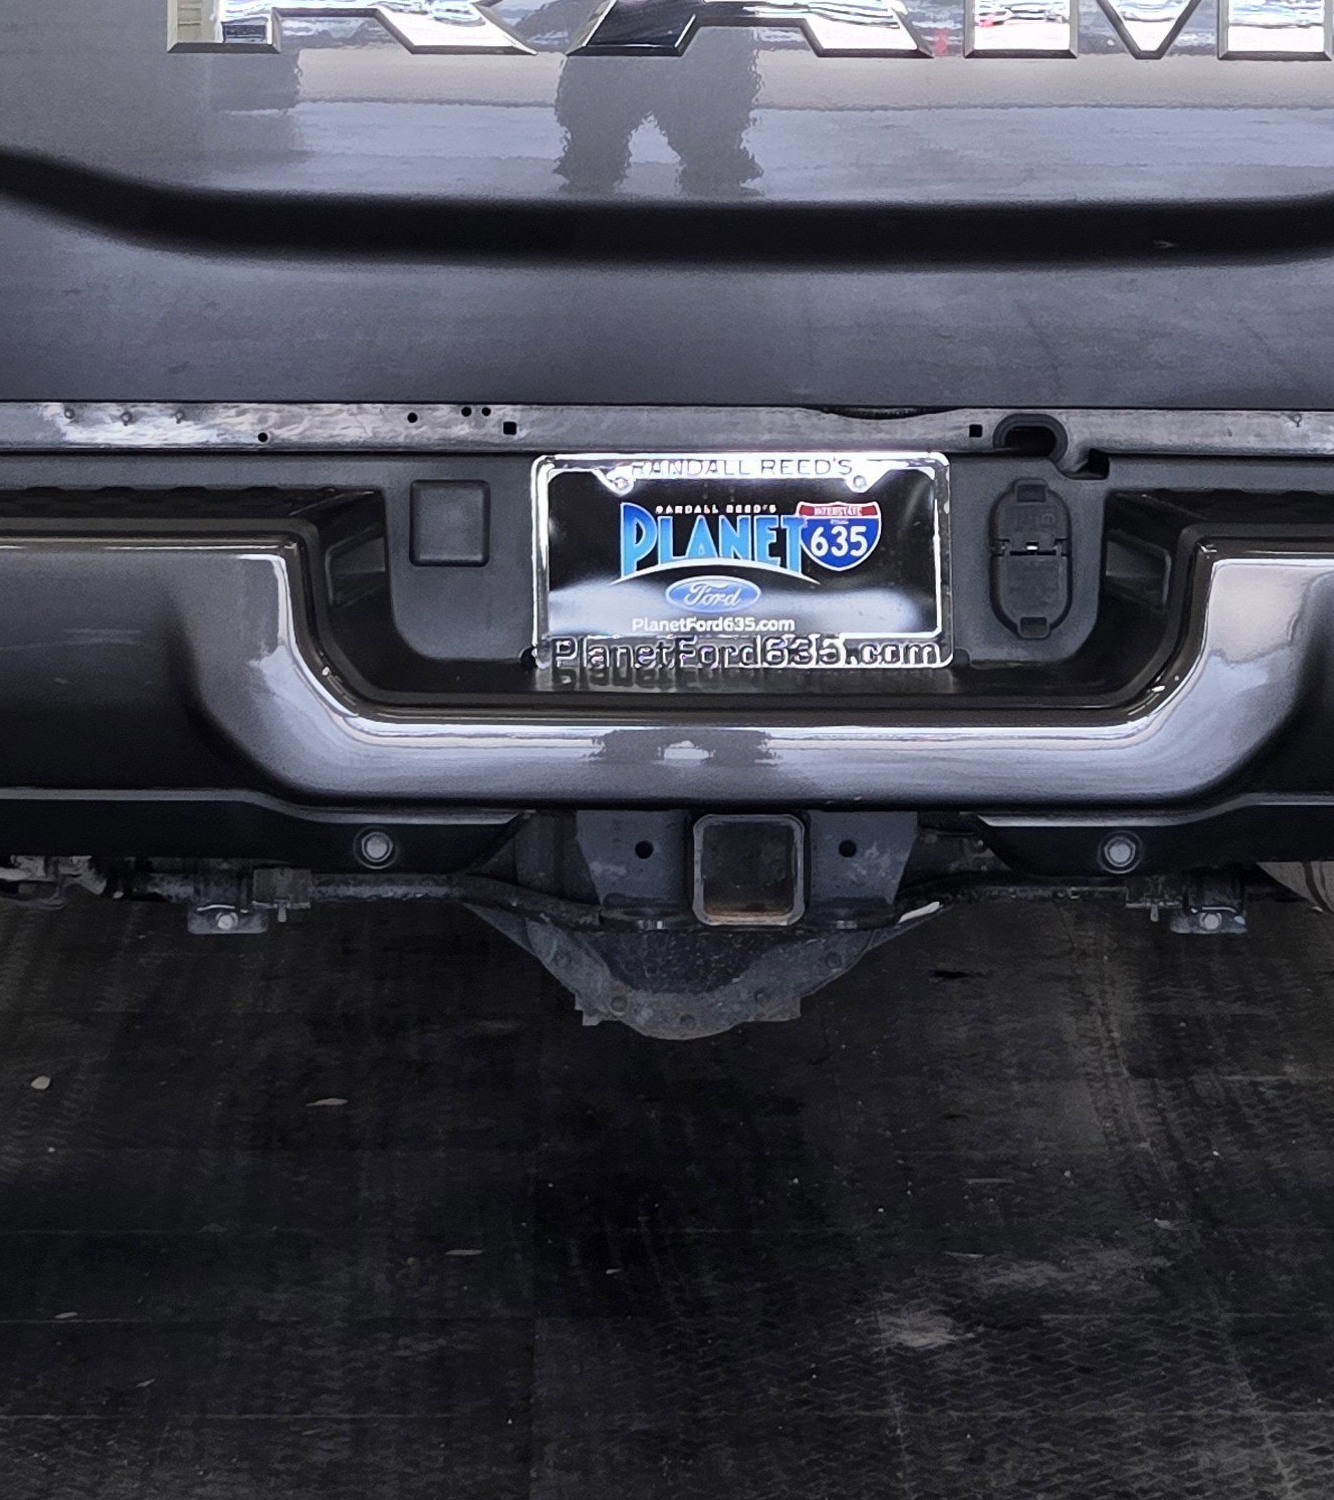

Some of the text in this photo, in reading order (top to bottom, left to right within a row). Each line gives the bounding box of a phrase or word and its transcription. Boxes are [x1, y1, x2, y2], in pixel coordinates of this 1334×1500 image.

[631, 457, 853, 477] RANDALL REED'S
[620, 502, 808, 579] PLANET
[810, 525, 868, 557] 635
[683, 583, 742, 608] Ford
[632, 616, 795, 634] PlanetFord635.com
[553, 634, 943, 669] PlanetFord635.com
